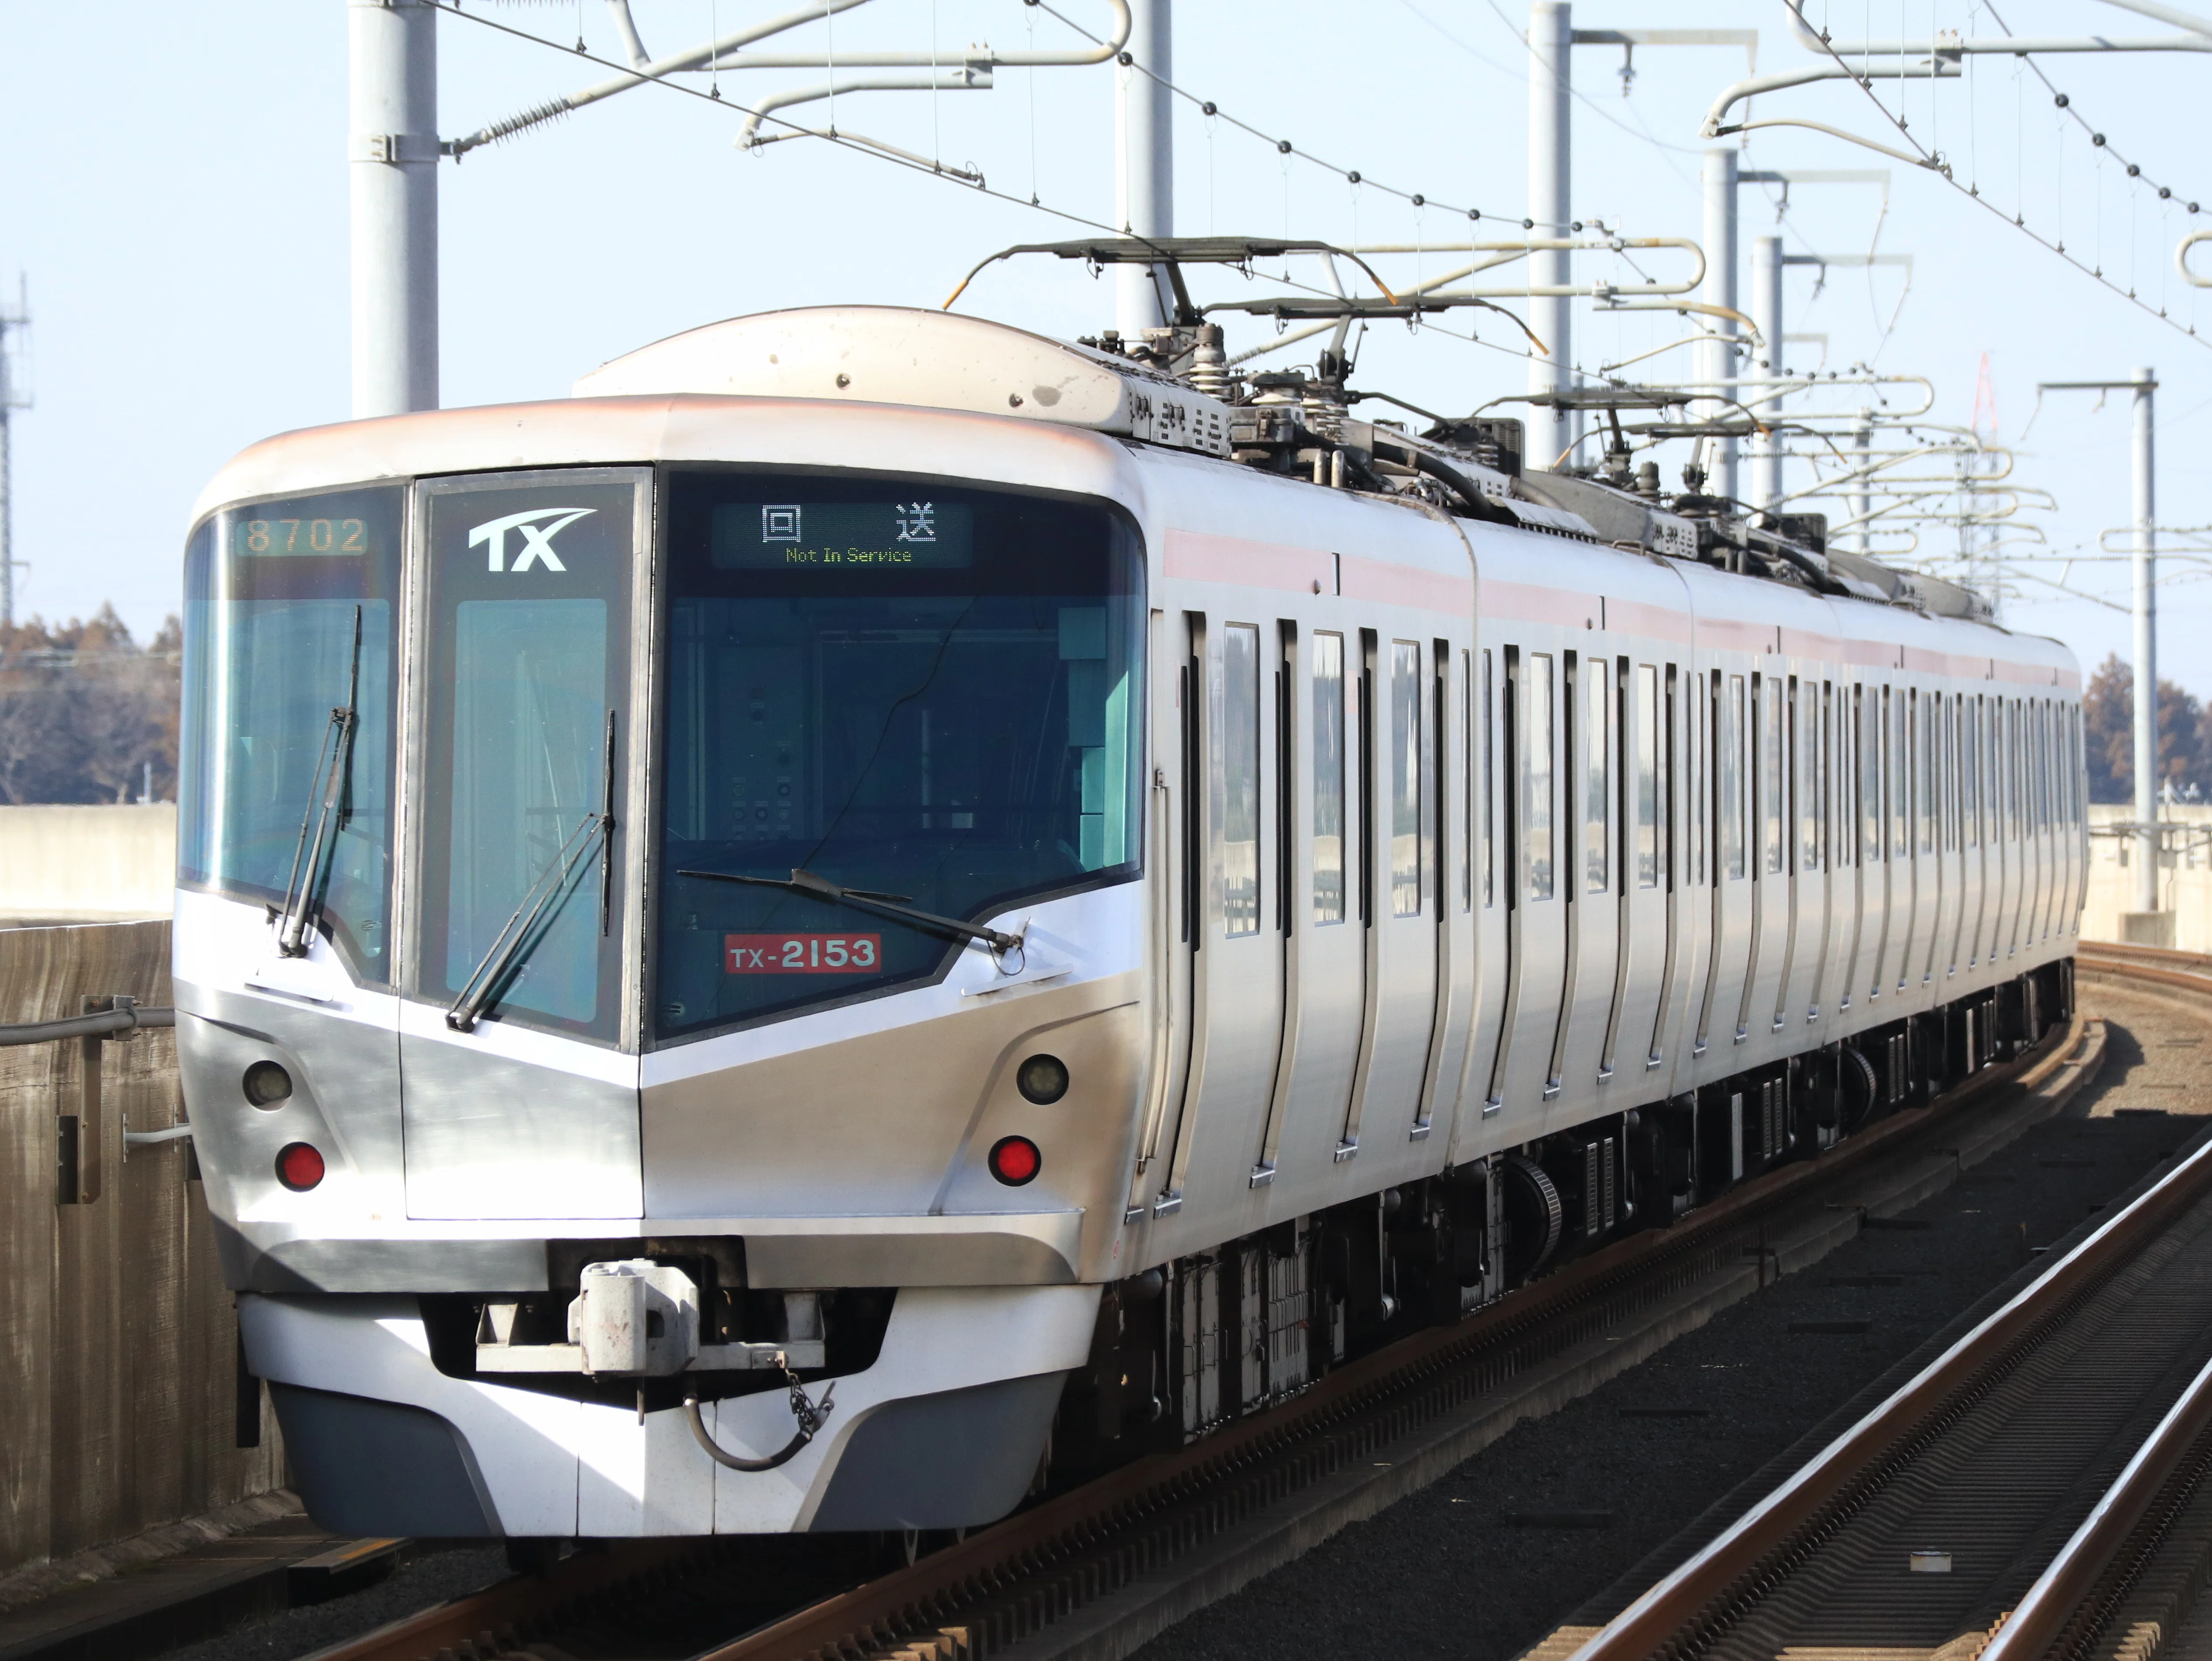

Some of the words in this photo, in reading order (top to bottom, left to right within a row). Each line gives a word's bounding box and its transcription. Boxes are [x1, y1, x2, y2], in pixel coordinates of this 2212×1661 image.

[247, 519, 363, 551] 8702
[468, 508, 598, 572] TX
[786, 548, 816, 563] Not
[823, 547, 840, 562] In
[847, 547, 911, 562] Service
[730, 939, 876, 968] TX-2153
